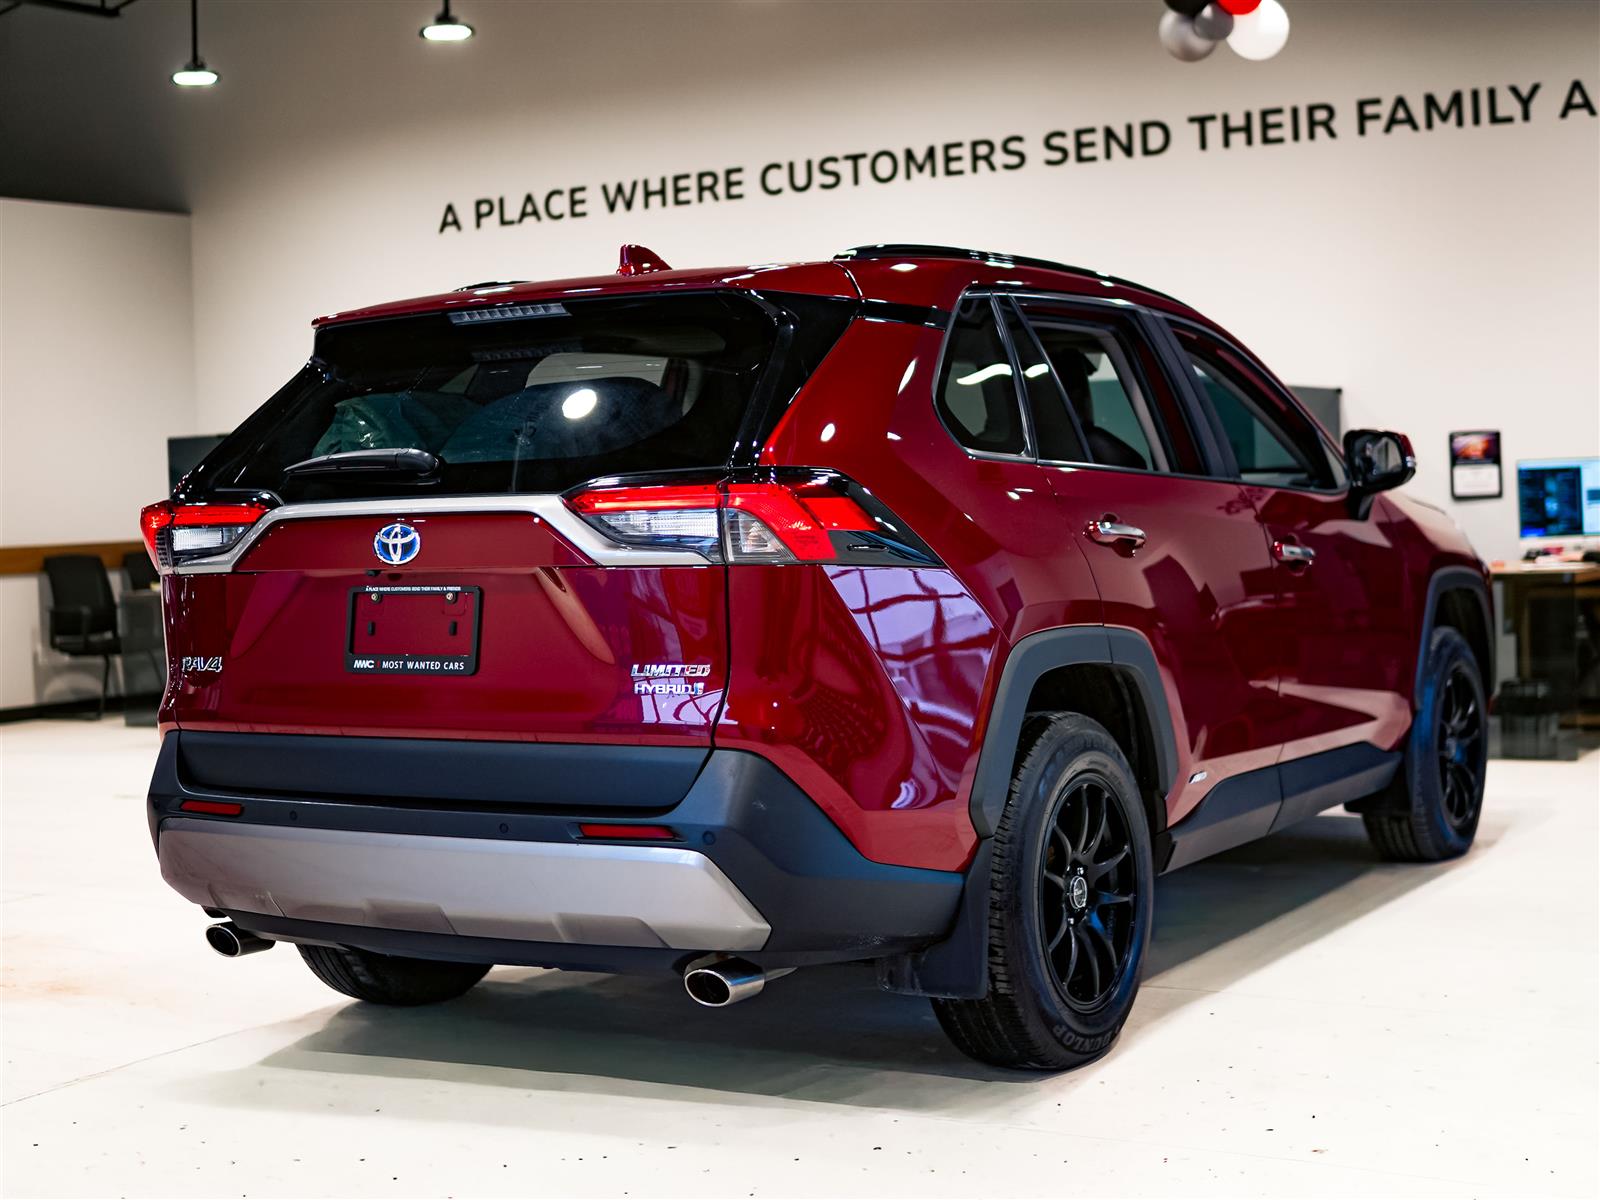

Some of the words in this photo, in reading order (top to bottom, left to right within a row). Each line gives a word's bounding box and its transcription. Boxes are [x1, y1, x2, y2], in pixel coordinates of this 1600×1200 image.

[439, 204, 461, 233] A
[475, 186, 587, 229] PLACE
[602, 167, 744, 213] WHERE
[760, 135, 1026, 196] CUSTOMERS
[1044, 120, 1171, 166] SEND
[1187, 103, 1337, 151] THEIR
[1356, 82, 1541, 136] FAMILY
[382, 661, 404, 669] MOST
[407, 661, 441, 670] WANTED
[443, 662, 465, 670] CARS
[631, 664, 711, 677] LIMITED
